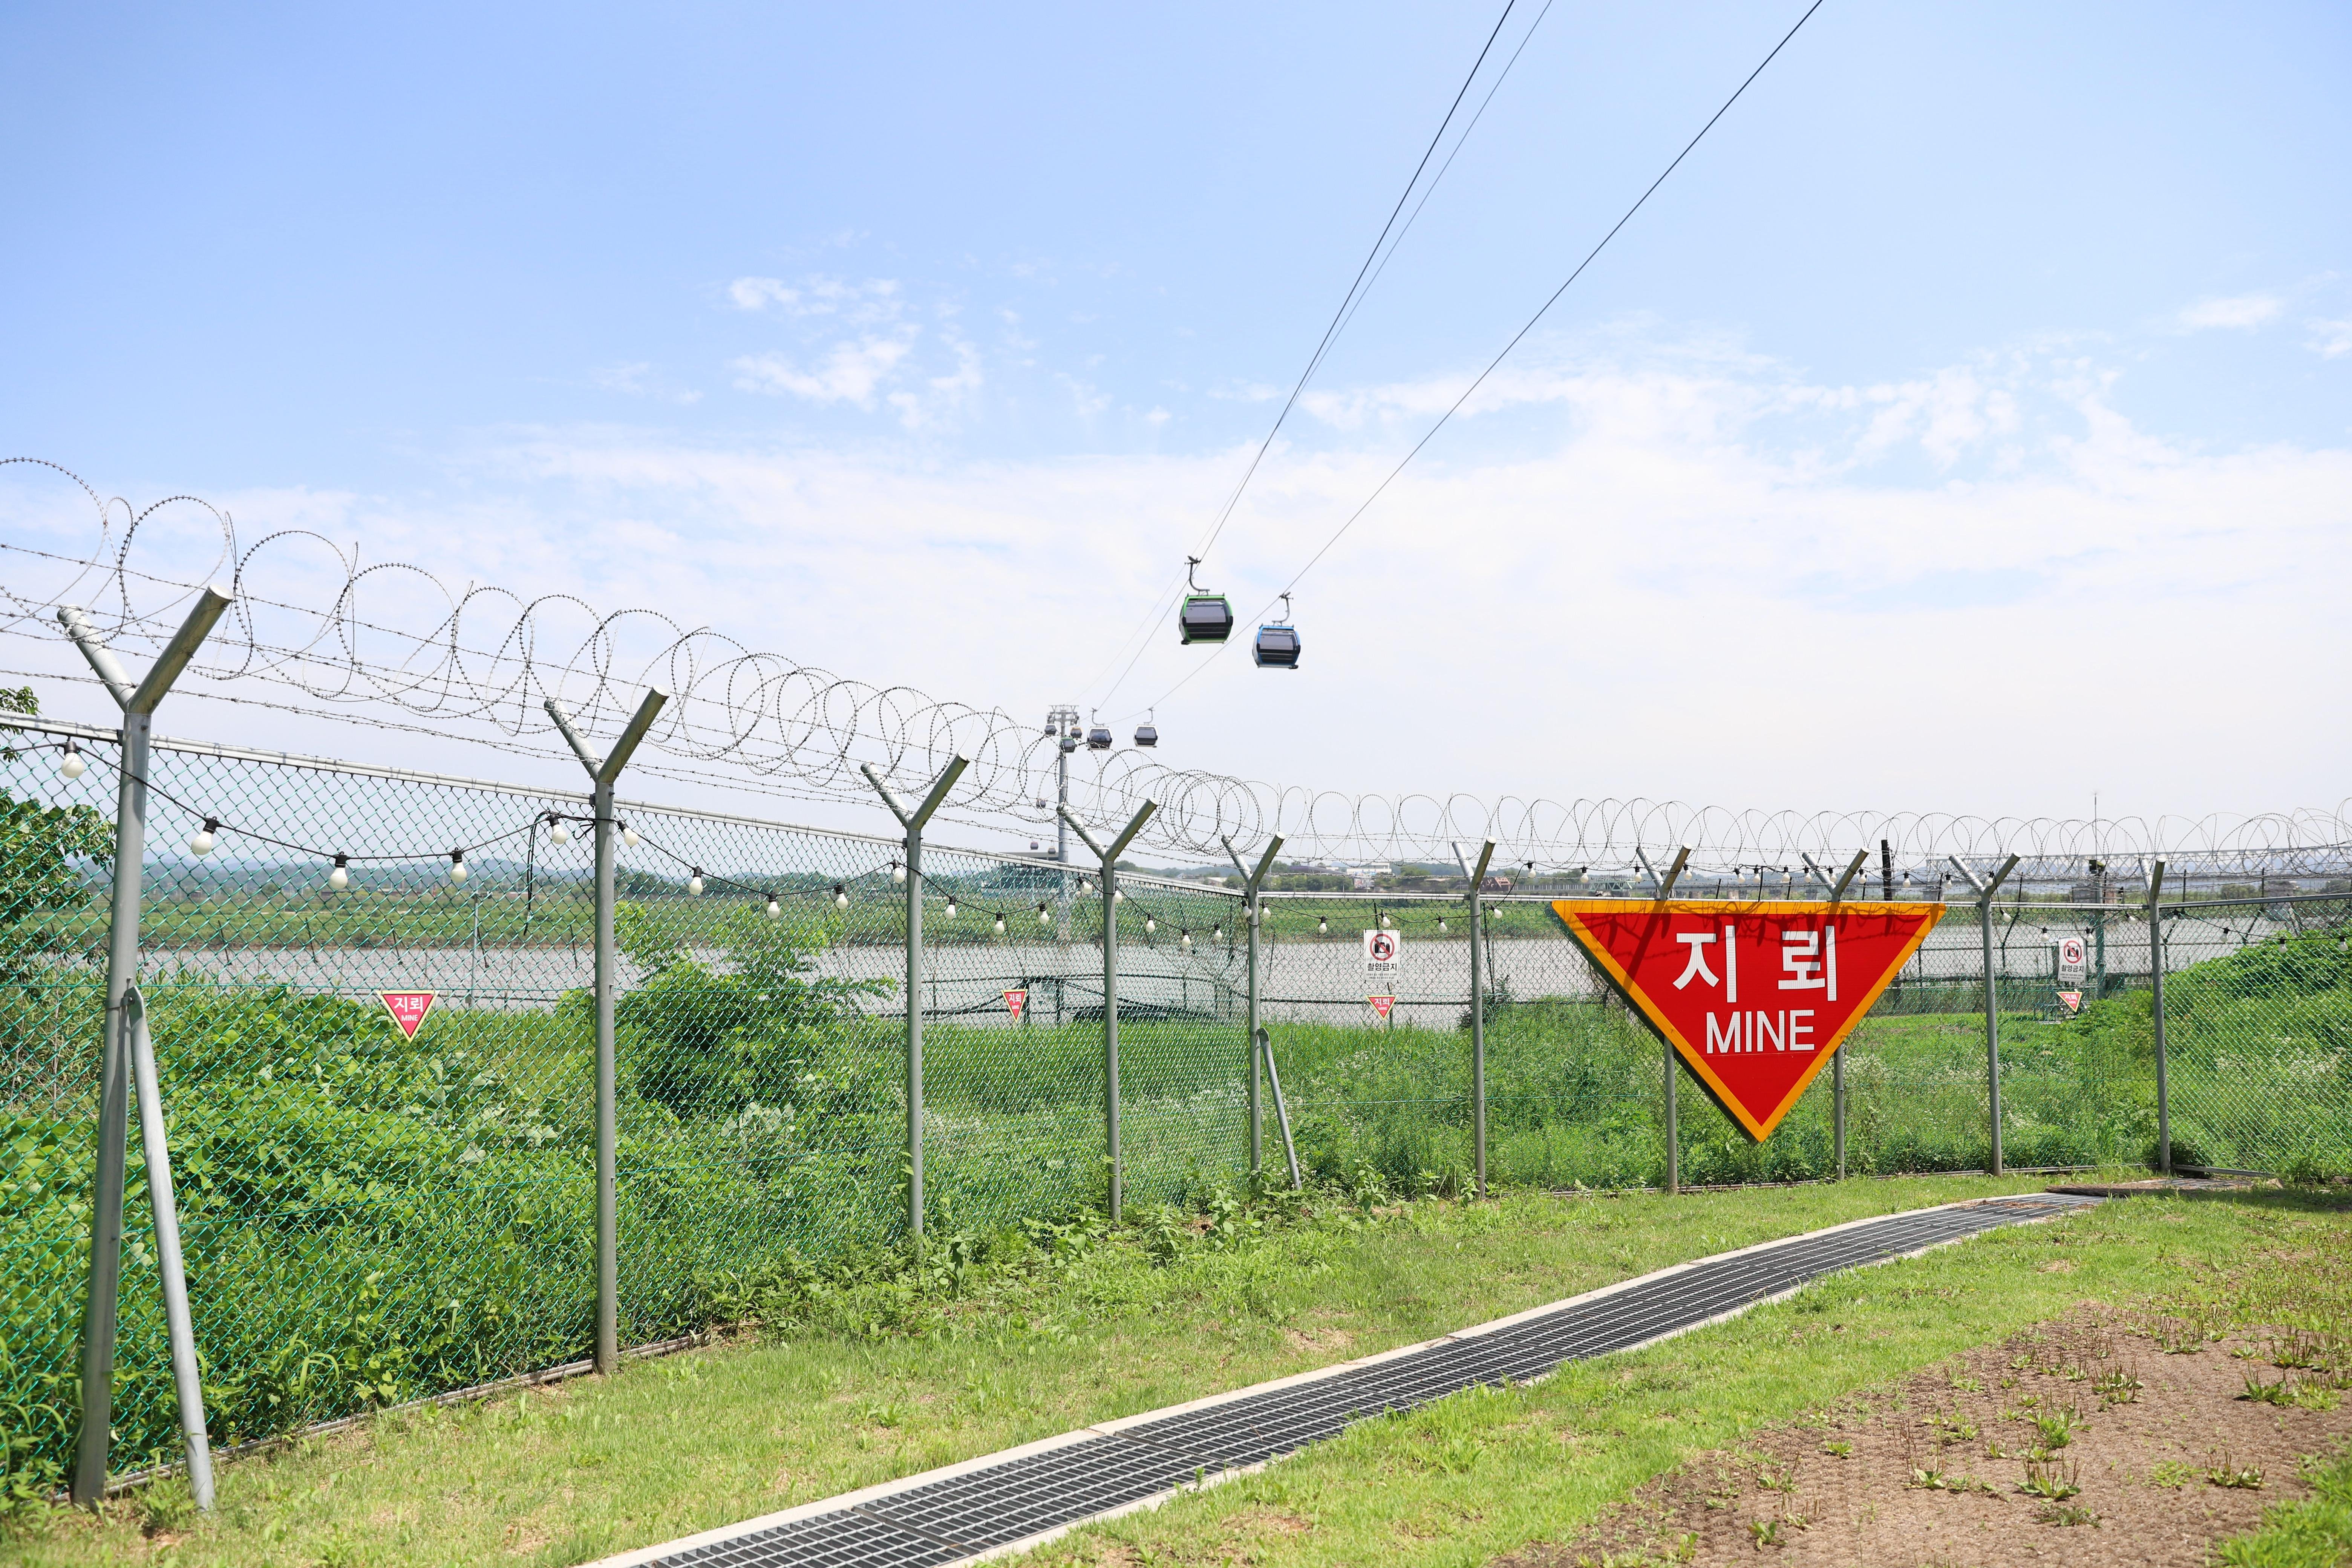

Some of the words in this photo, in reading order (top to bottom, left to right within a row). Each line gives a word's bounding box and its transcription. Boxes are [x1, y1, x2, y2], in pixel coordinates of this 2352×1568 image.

[1673, 925, 1837, 1003] 지뢰
[394, 996, 423, 1012] 지뢰
[1009, 993, 1021, 1004] 지뢰
[1706, 1009, 1815, 1054] MINE
